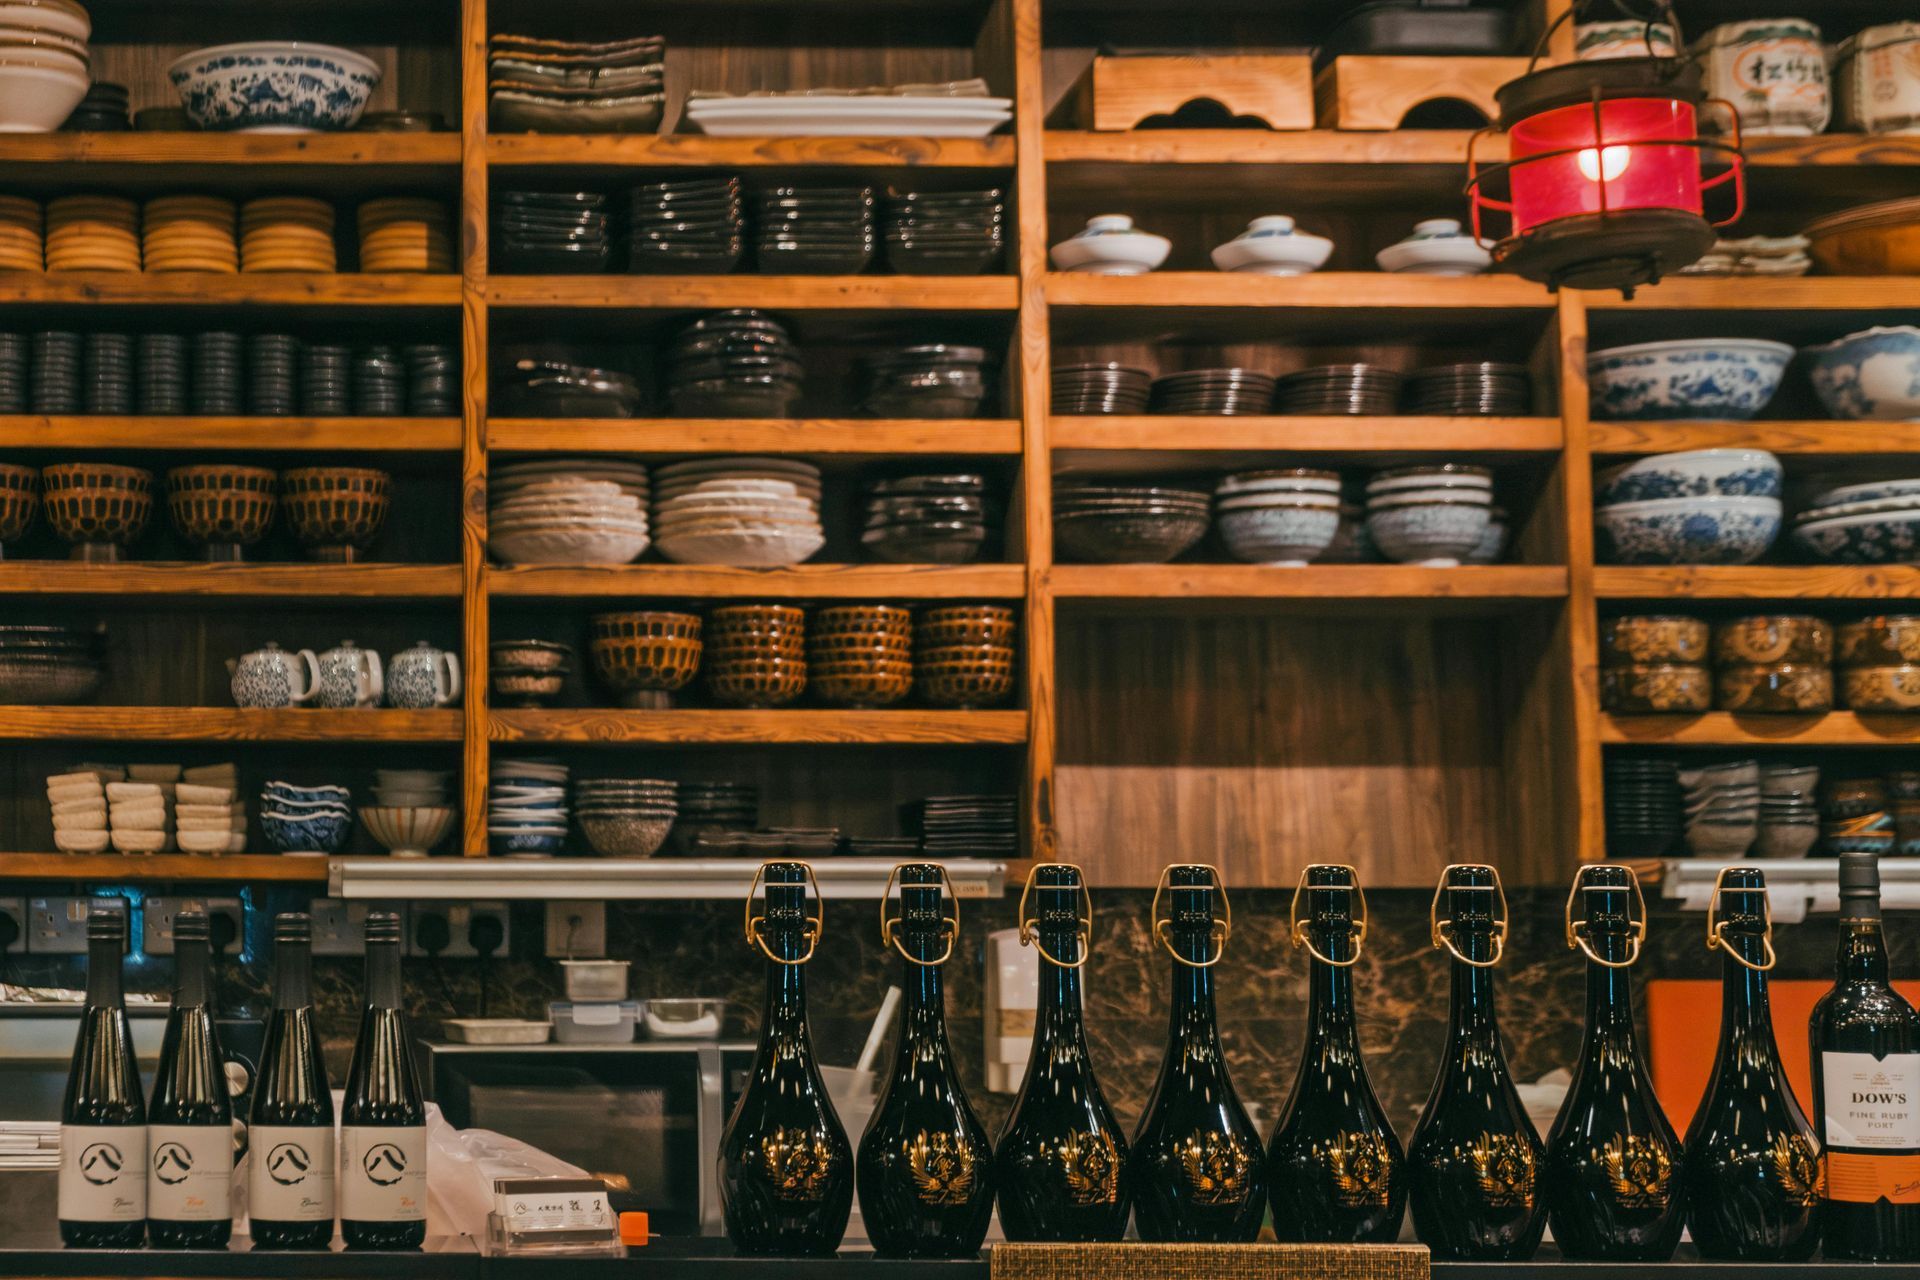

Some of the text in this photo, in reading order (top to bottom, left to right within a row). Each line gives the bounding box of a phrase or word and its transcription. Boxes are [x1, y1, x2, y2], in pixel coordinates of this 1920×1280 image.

[1852, 1092, 1907, 1104] DOW'S
[1849, 1111, 1909, 1120] FINE RUBY
